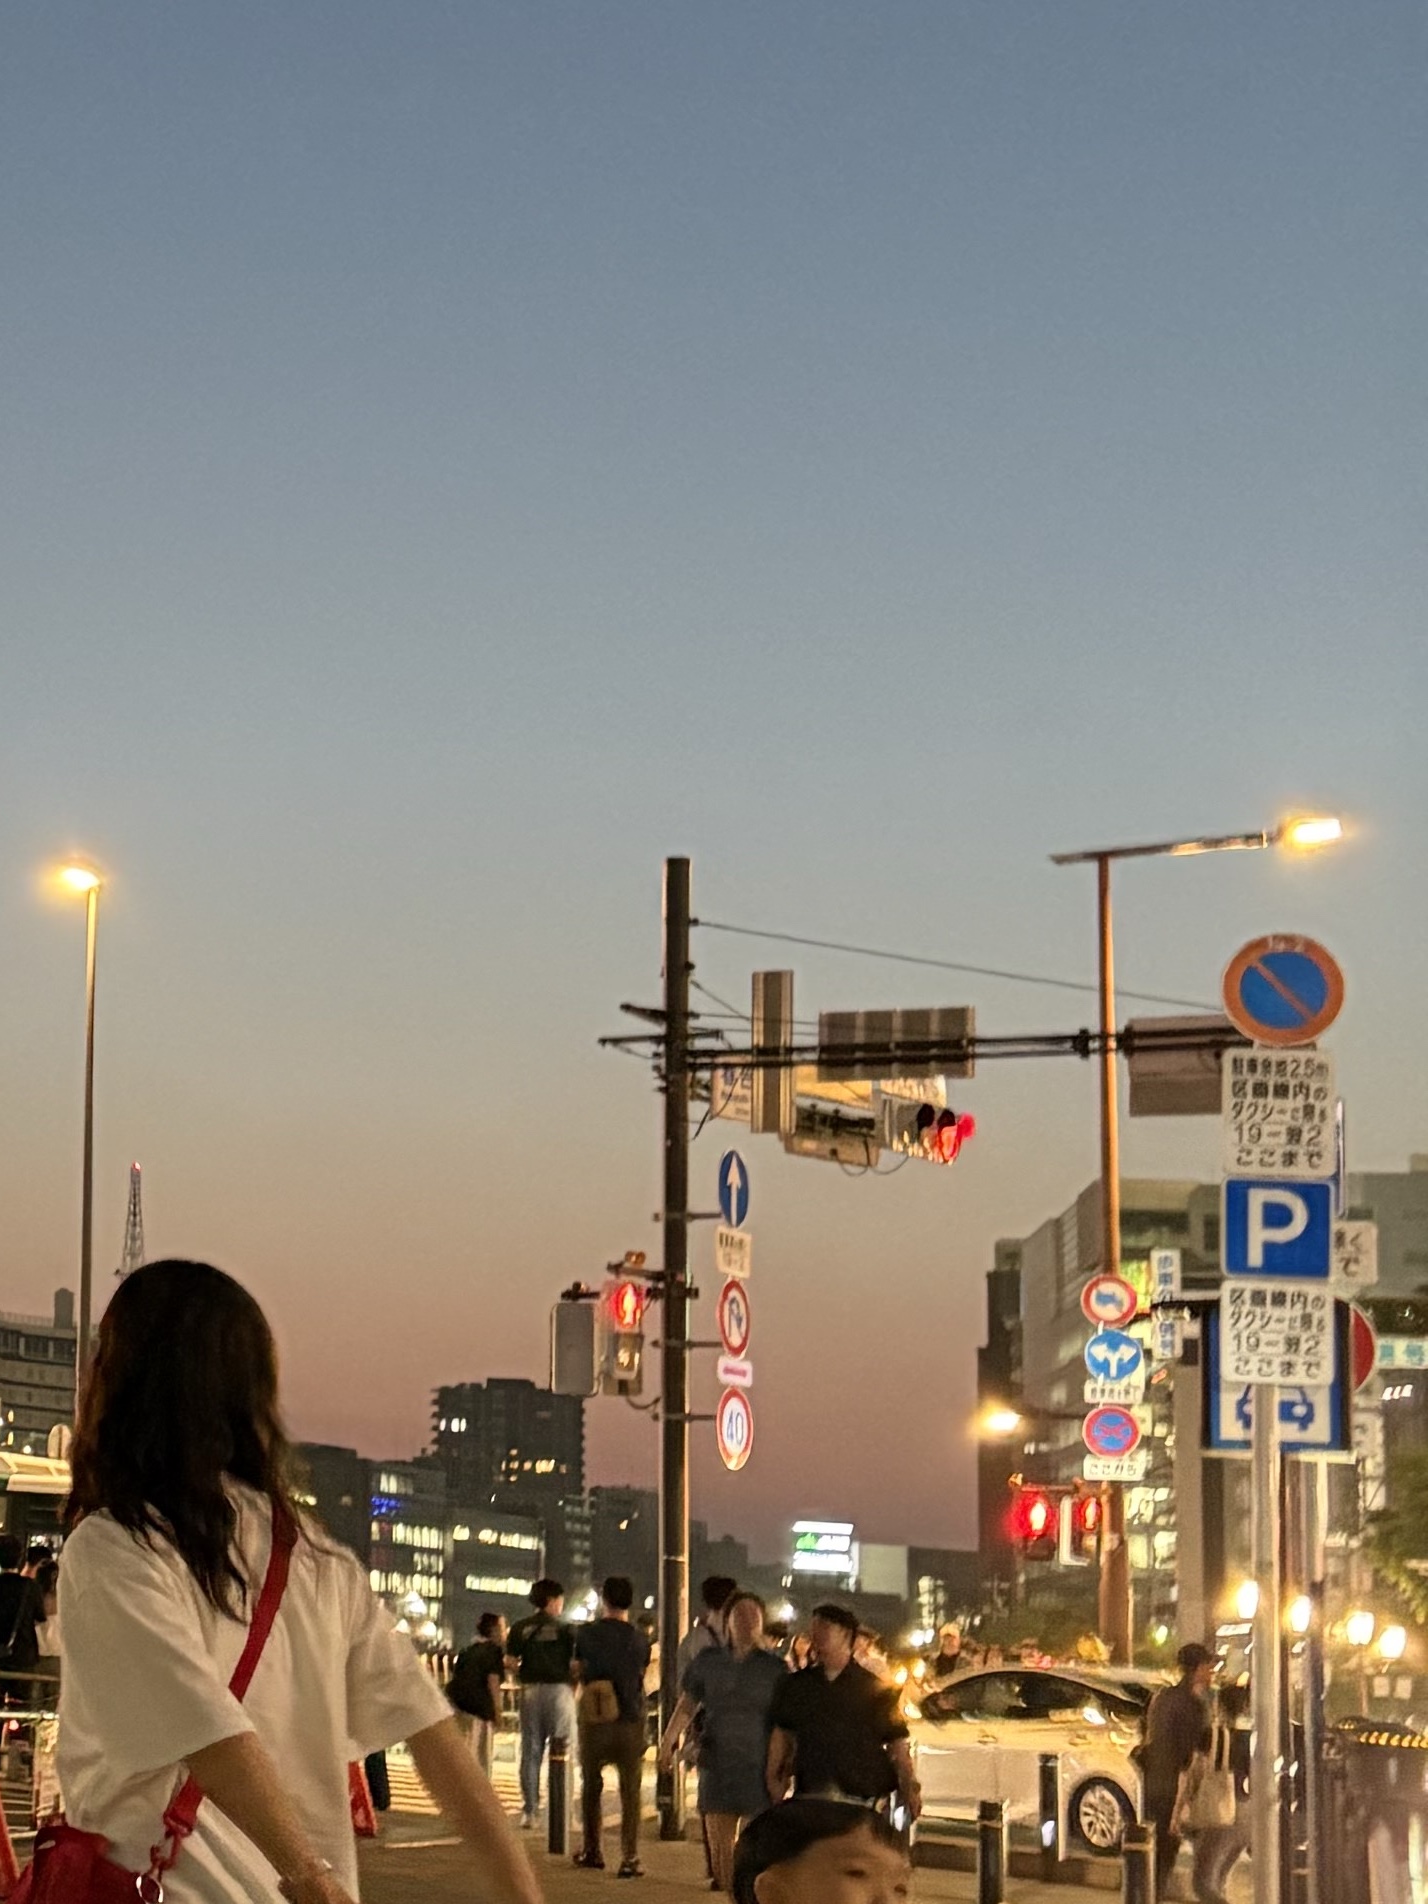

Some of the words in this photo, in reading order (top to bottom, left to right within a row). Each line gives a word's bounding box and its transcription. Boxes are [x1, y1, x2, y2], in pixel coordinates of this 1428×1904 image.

[1236, 1148, 1323, 1169] ここまで
[1247, 1187, 1308, 1268] P
[1234, 1358, 1321, 1379] ここまで
[726, 1410, 744, 1446] 40
